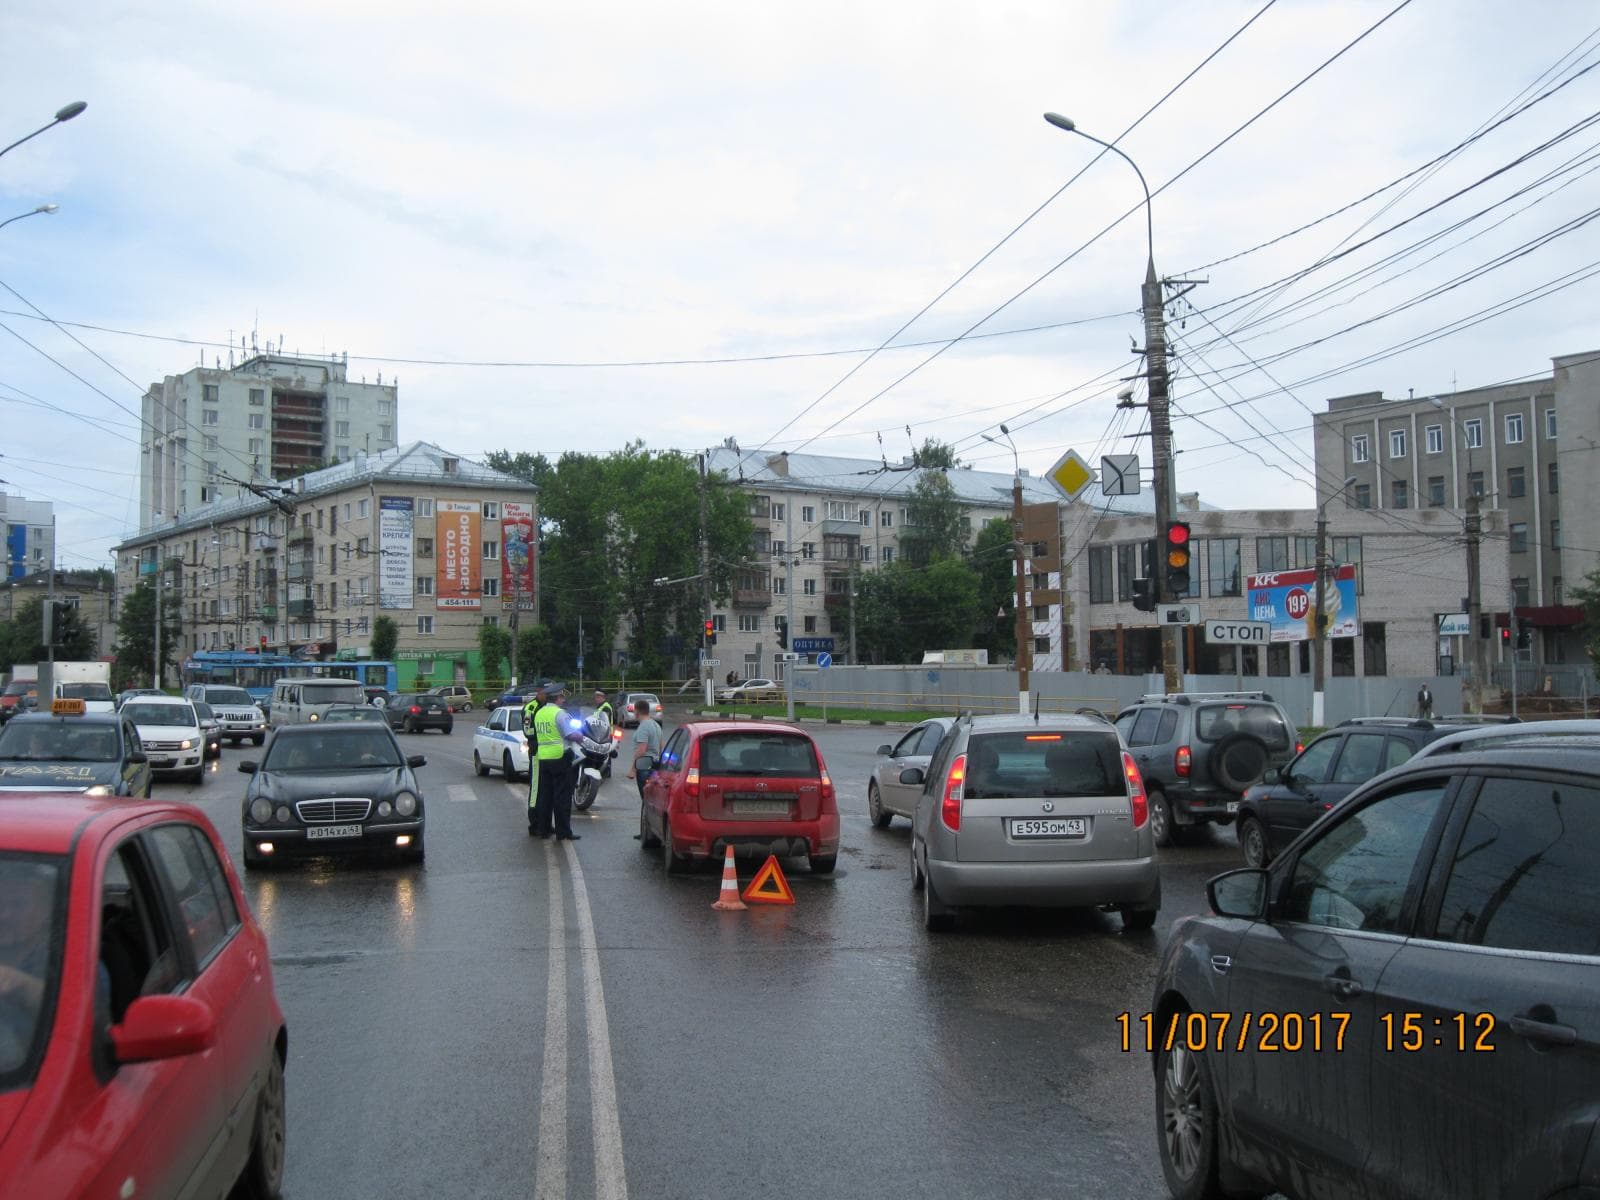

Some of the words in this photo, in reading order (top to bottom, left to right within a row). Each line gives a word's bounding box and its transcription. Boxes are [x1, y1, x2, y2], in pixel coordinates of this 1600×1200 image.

[446, 530, 456, 580] МЕСТО
[1254, 574, 1279, 586] KFC
[1254, 605, 1276, 620] ЦЕНА
[1213, 626, 1263, 640] СТОП
[794, 640, 833, 649] ОПТИКА
[1017, 821, 1066, 833] Е595ОМ
[1068, 820, 1081, 831] 43
